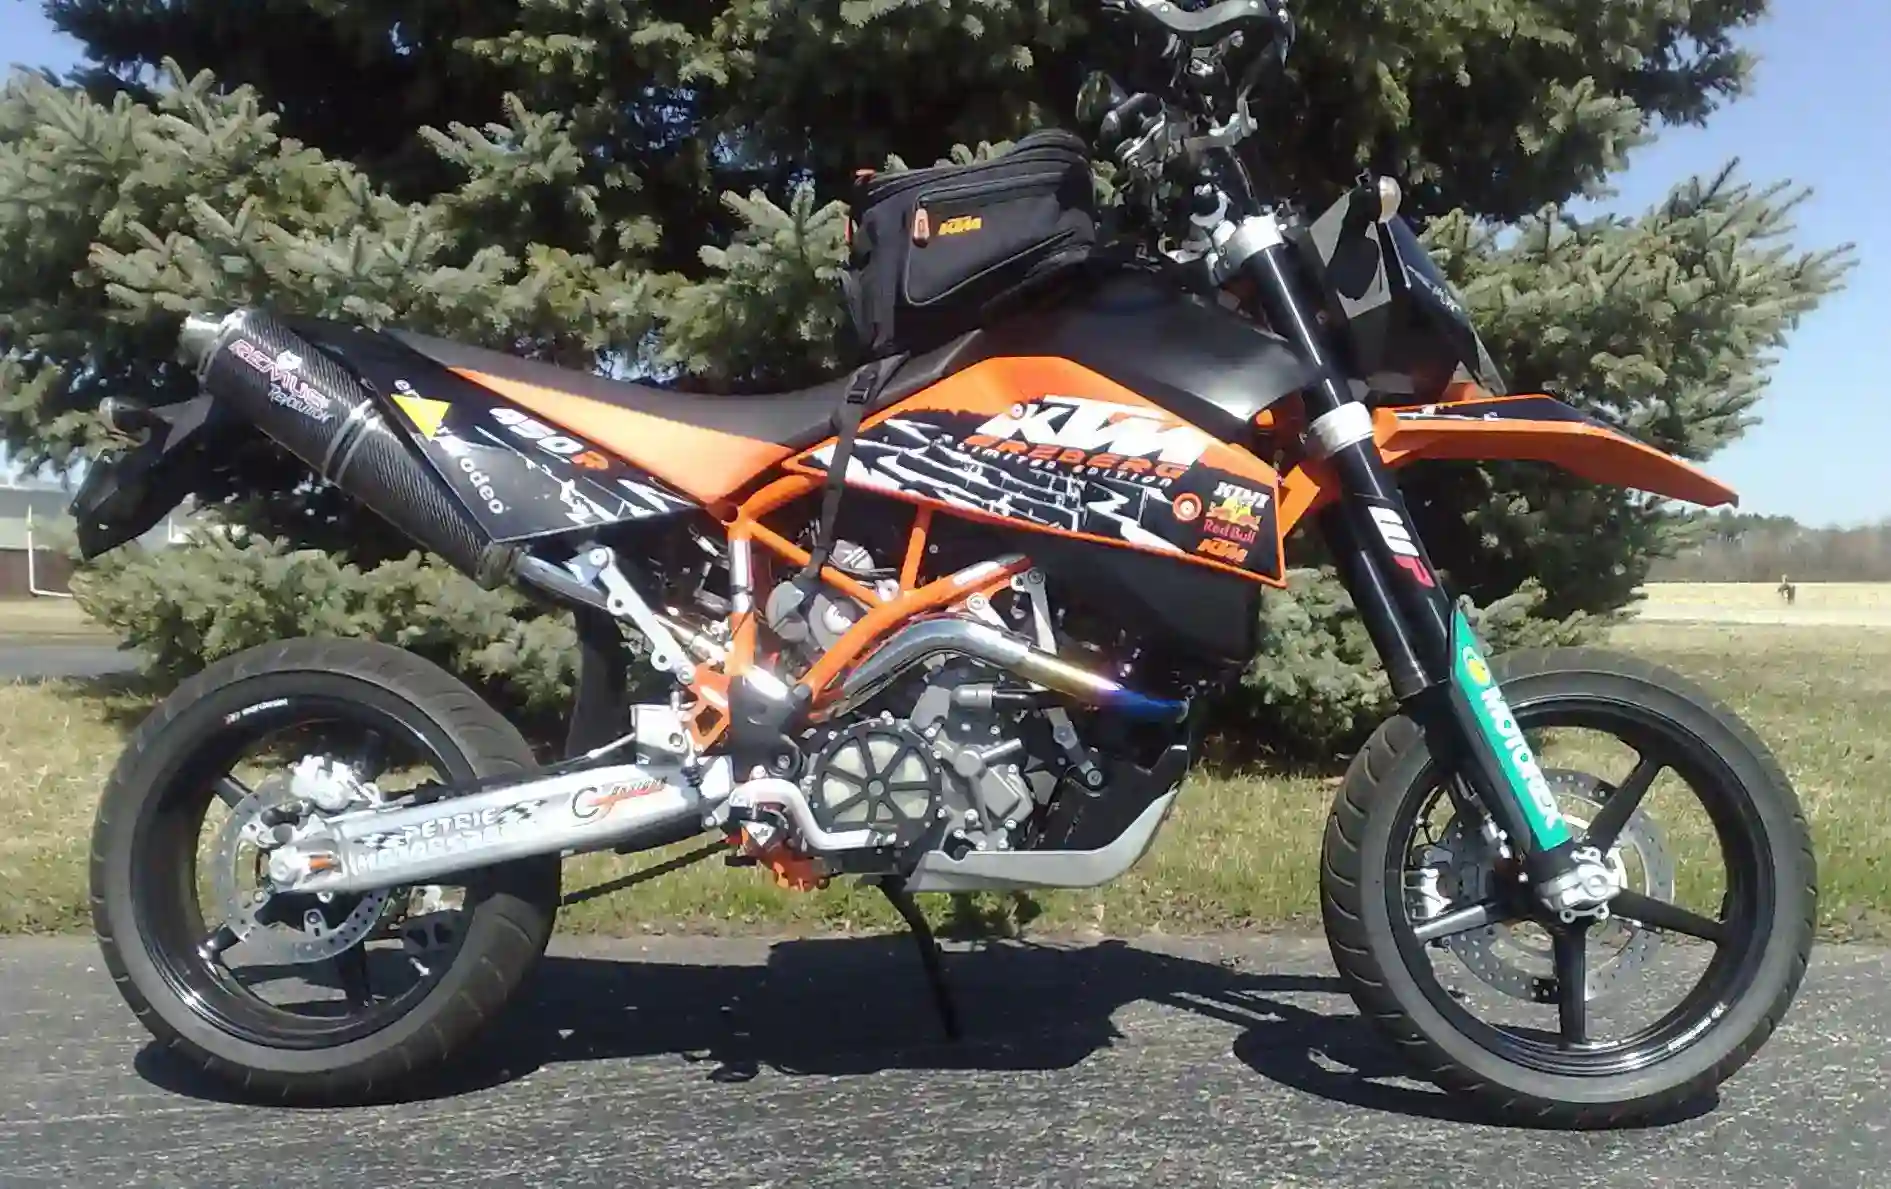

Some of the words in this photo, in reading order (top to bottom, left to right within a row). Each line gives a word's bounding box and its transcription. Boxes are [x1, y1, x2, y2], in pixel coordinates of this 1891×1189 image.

[228, 339, 331, 410] REMUS
[975, 394, 1213, 466] KTM
[963, 433, 1191, 480] ERZBERG
[1197, 537, 1249, 562] KTM
[1203, 518, 1231, 538] Red
[1229, 524, 1257, 544] Bull
[1481, 686, 1567, 831] MOTOREX
[401, 806, 503, 843] PETRIE
